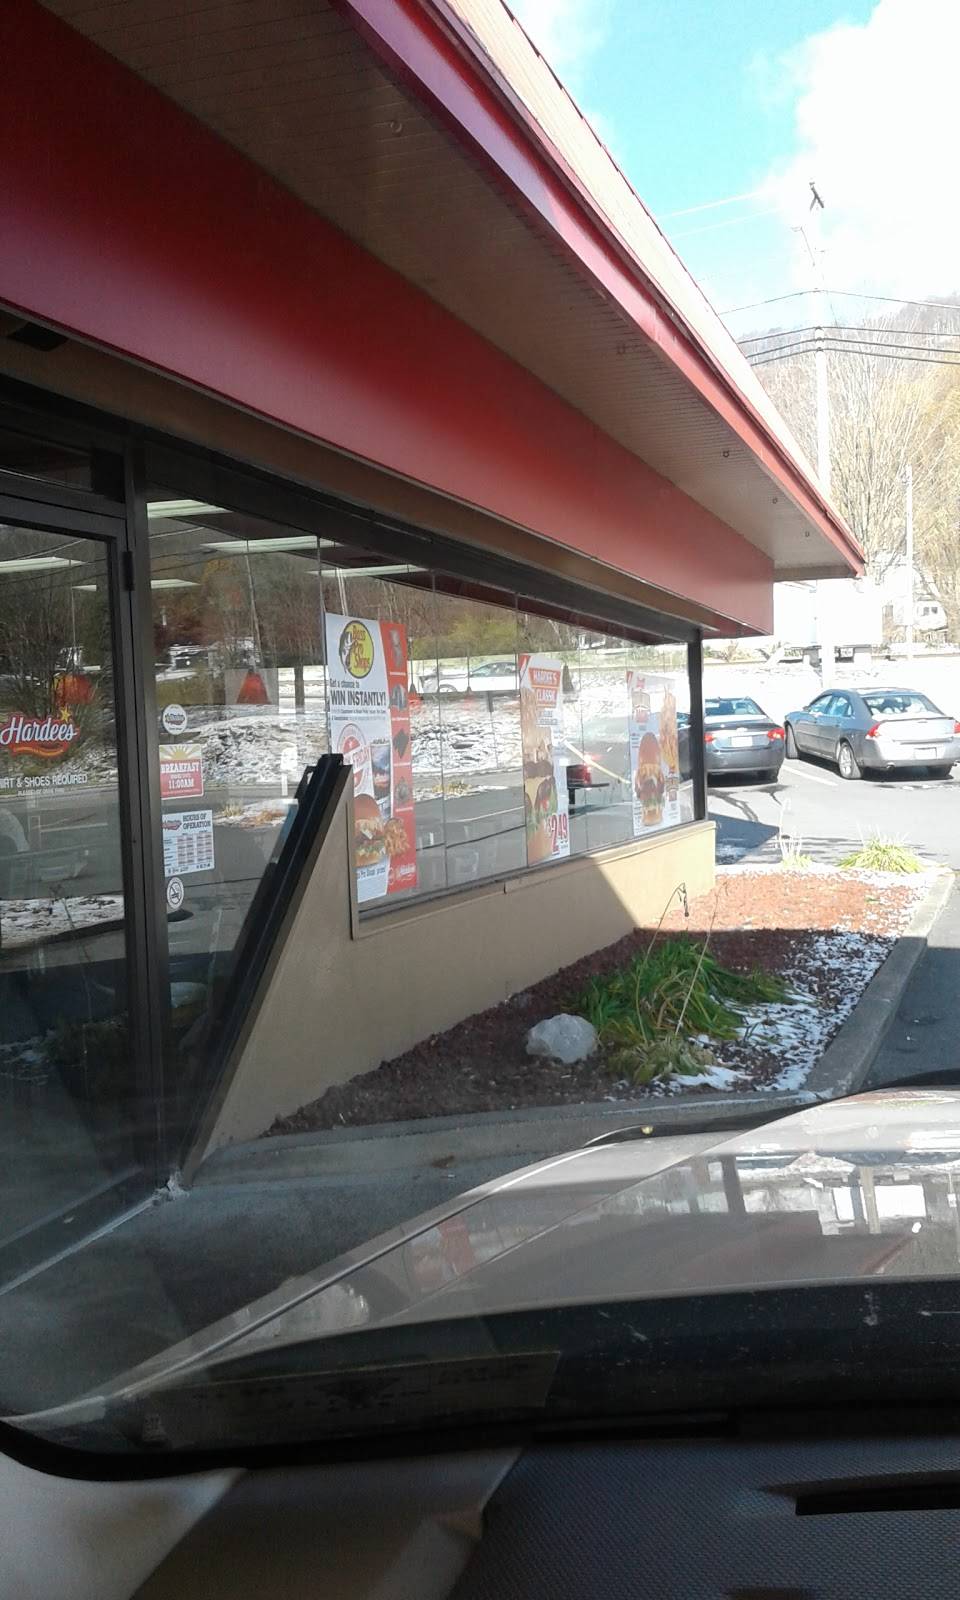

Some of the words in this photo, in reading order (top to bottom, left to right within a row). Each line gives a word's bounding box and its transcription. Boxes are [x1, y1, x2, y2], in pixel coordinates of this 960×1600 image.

[330, 690, 346, 706] WIN
[347, 691, 387, 707] INSTANTLY!
[160, 762, 200, 774] BREAKFAST
[16, 776, 22, 788] &
[24, 776, 51, 788] SHOES
[52, 773, 88, 786] REQUIRED
[182, 820, 211, 830] OPERATION
